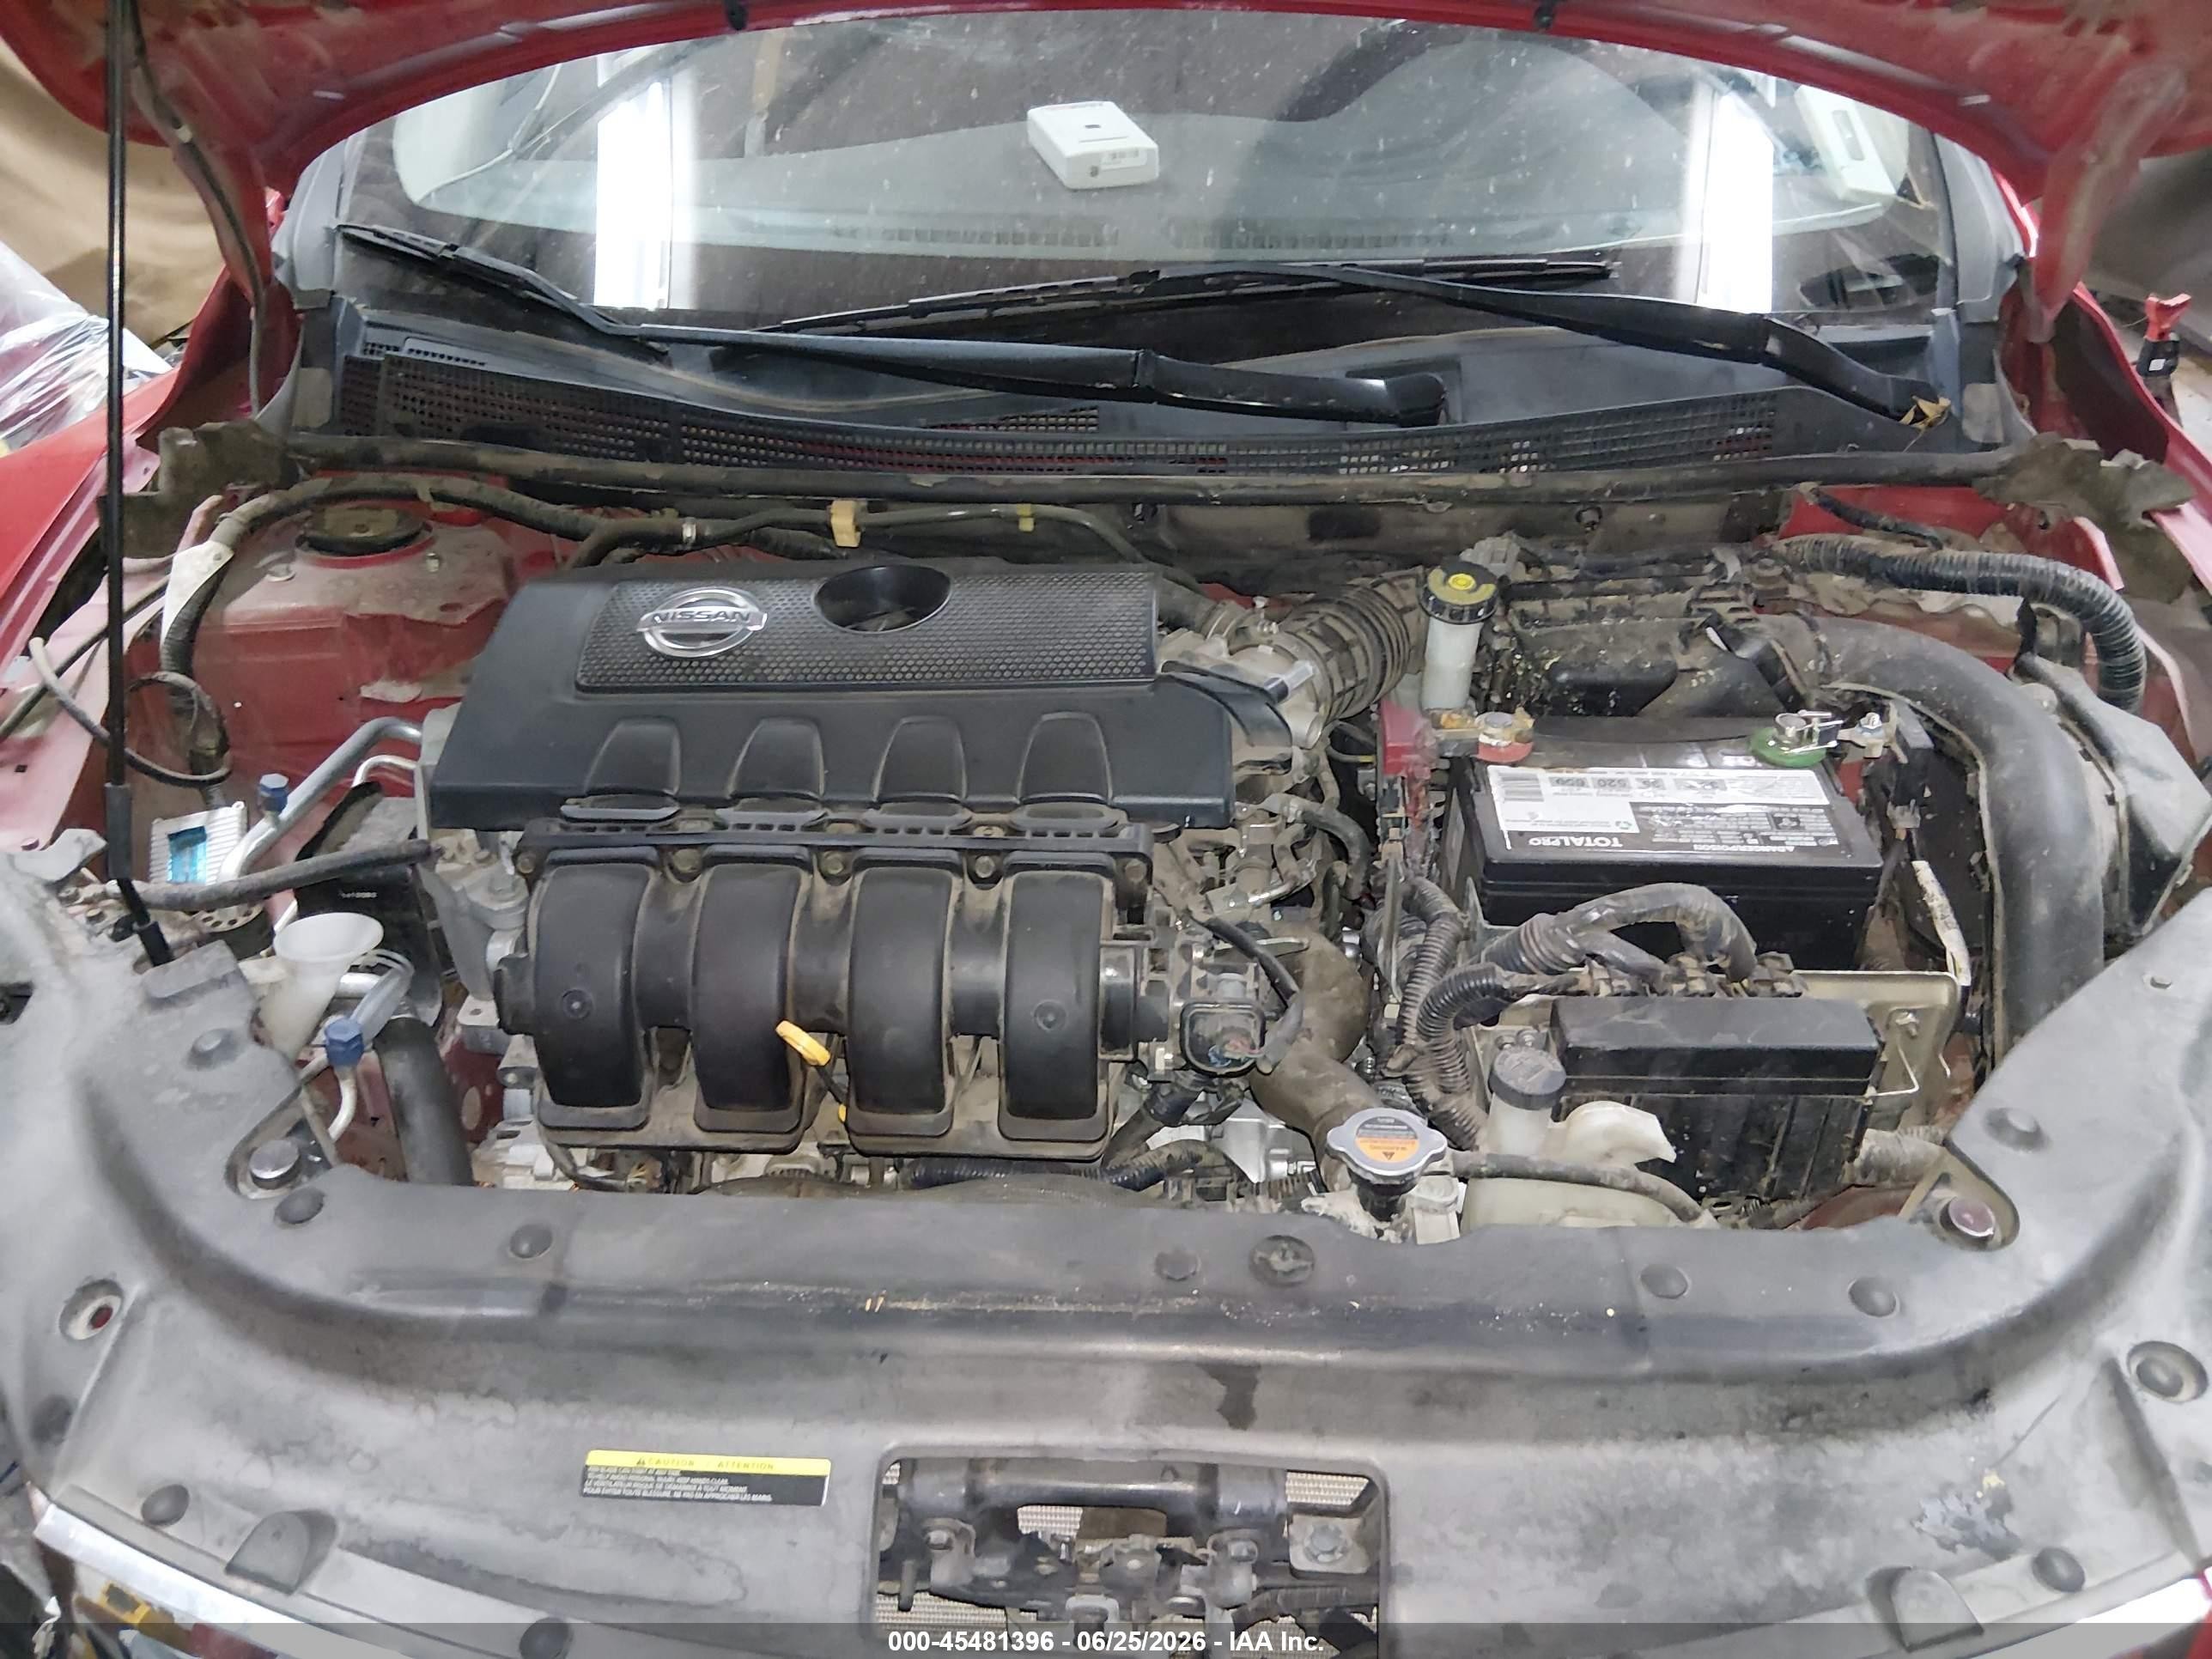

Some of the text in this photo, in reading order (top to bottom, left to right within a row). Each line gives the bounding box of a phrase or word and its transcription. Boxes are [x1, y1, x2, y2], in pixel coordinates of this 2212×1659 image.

[652, 611, 750, 623] NISSAN
[1597, 778, 1627, 788] 520
[1528, 836, 1624, 848] TOTALPRO
[647, 1456, 775, 1470] CAUTION ATTENTION
